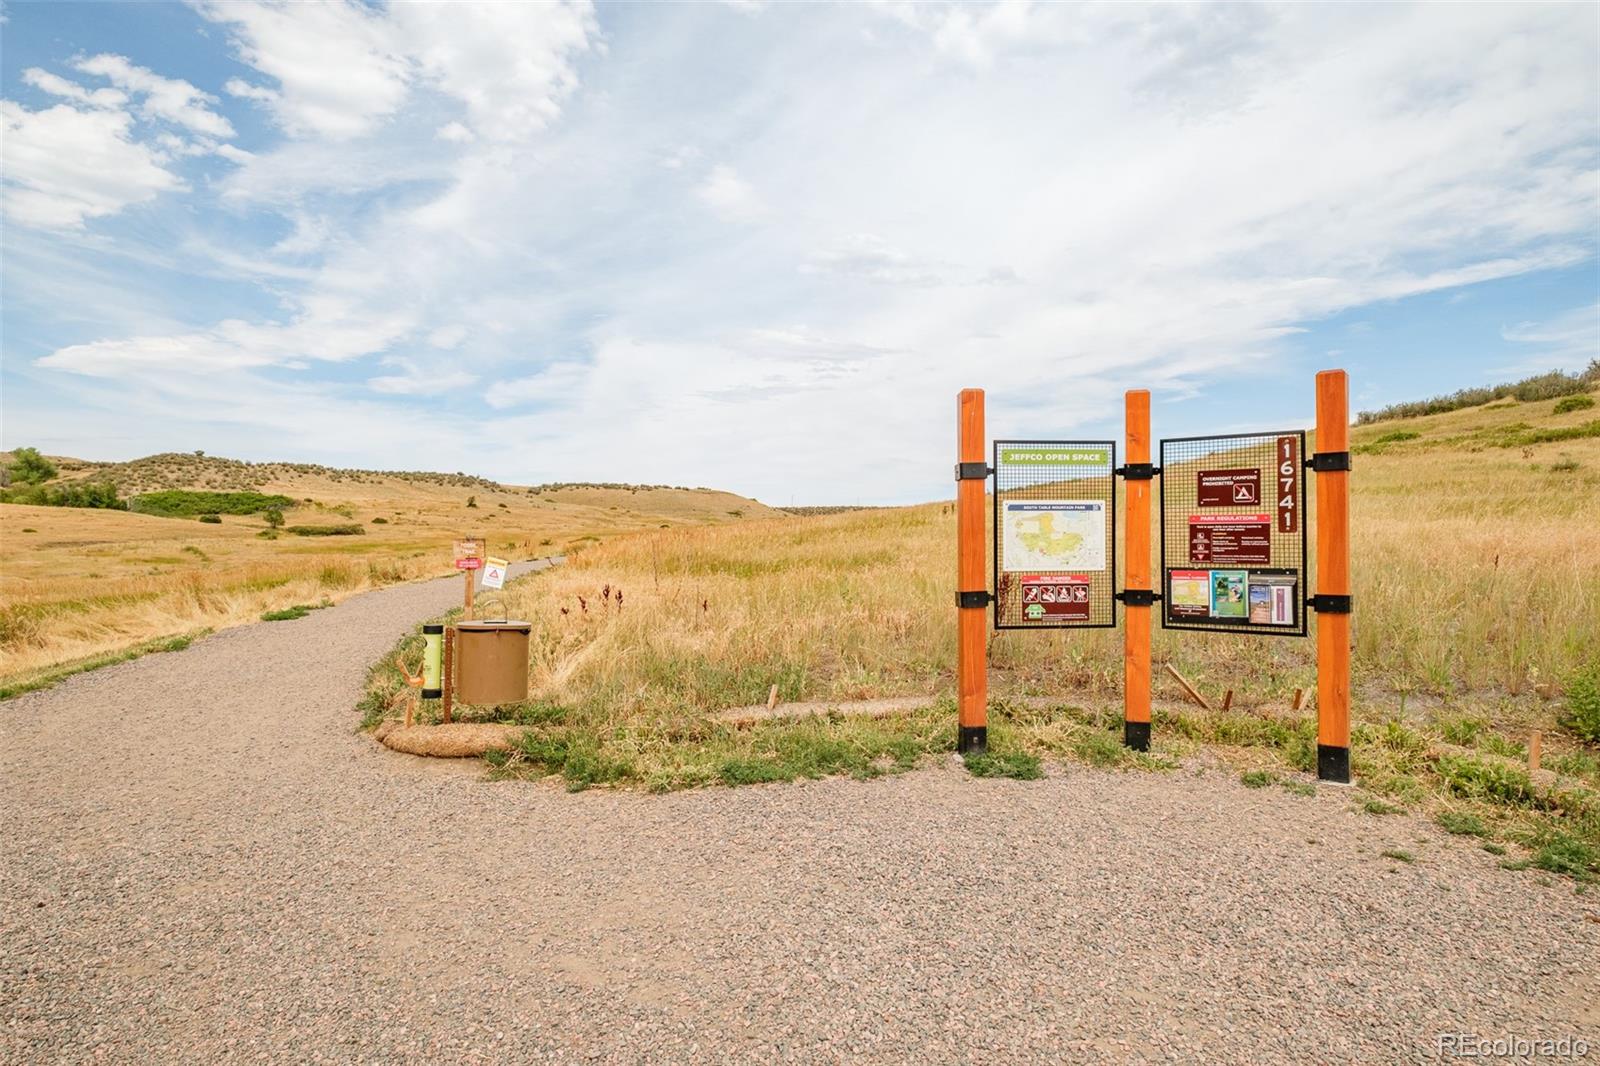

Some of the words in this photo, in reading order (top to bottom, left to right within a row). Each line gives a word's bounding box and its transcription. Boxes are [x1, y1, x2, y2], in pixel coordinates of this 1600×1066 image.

[1009, 453, 1043, 461] JEFFCO
[1045, 453, 1070, 461] OPEN
[1072, 453, 1101, 461] SPACE
[1280, 443, 1294, 527] 16741
